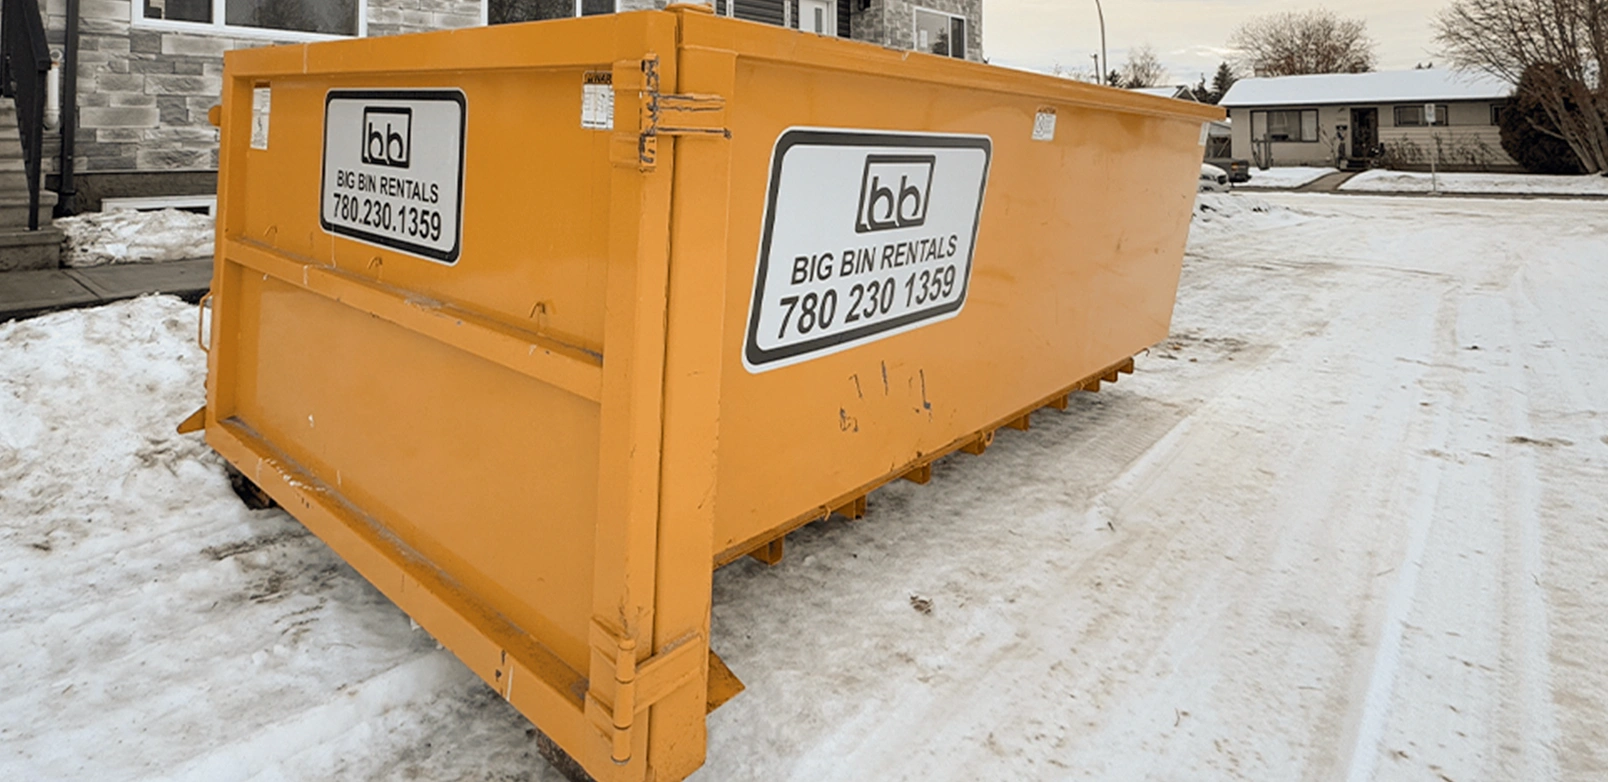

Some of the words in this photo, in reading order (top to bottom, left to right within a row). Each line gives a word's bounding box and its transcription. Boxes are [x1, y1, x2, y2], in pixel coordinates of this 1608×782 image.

[337, 169, 355, 188] BIG
[358, 174, 377, 192] BIN
[380, 176, 439, 204] RENTALS
[333, 193, 442, 241] 780.230.1359
[791, 252, 834, 285] BIG
[840, 247, 876, 277] BIN
[880, 234, 958, 270] RENTALS
[779, 289, 837, 338] 780
[845, 277, 895, 323] 230
[904, 264, 956, 307] 1359
